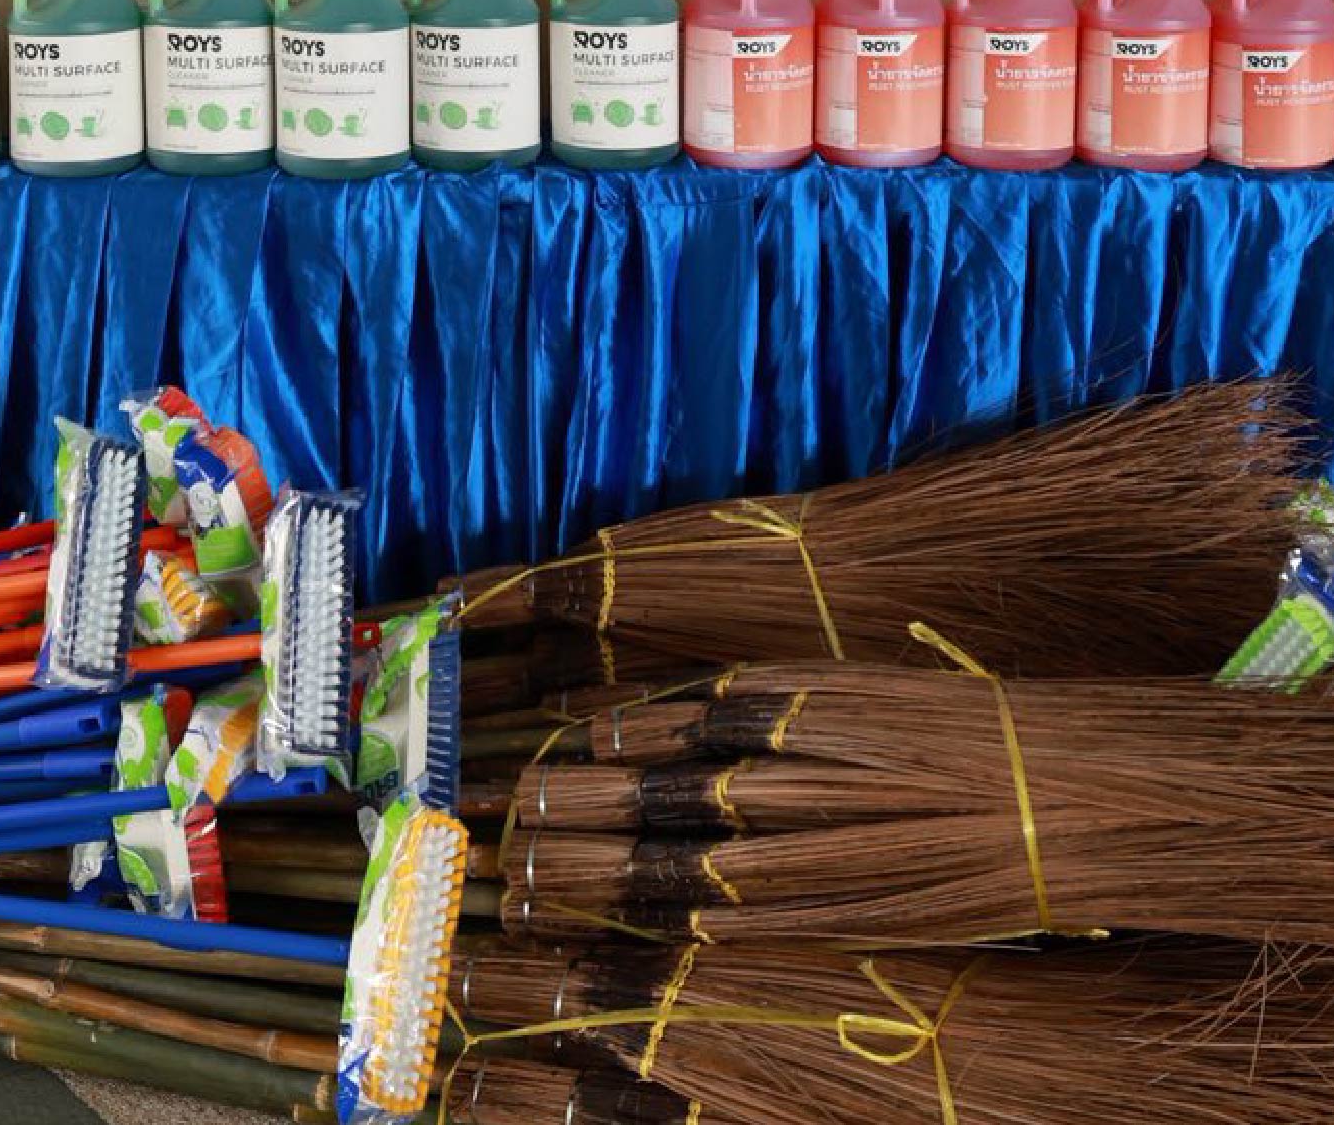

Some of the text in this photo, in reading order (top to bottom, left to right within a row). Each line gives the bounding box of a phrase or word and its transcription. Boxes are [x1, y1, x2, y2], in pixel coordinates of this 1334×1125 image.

[168, 33, 222, 53] ROYS
[281, 35, 326, 57] ROYS
[416, 31, 461, 52] ROYS
[573, 31, 628, 51] ROYS
[737, 41, 776, 54] ROYS
[861, 40, 901, 54] ROYS
[989, 38, 1030, 51] ROYS
[14, 42, 60, 60] ROYS
[1117, 43, 1158, 55] ROYS
[168, 57, 210, 70] MULTI
[318, 59, 387, 76] SURFACE
[453, 53, 518, 68] SURFACE
[573, 53, 616, 67] MULTI
[1247, 55, 1289, 68] ROYS
[53, 60, 121, 78] SURFACE
